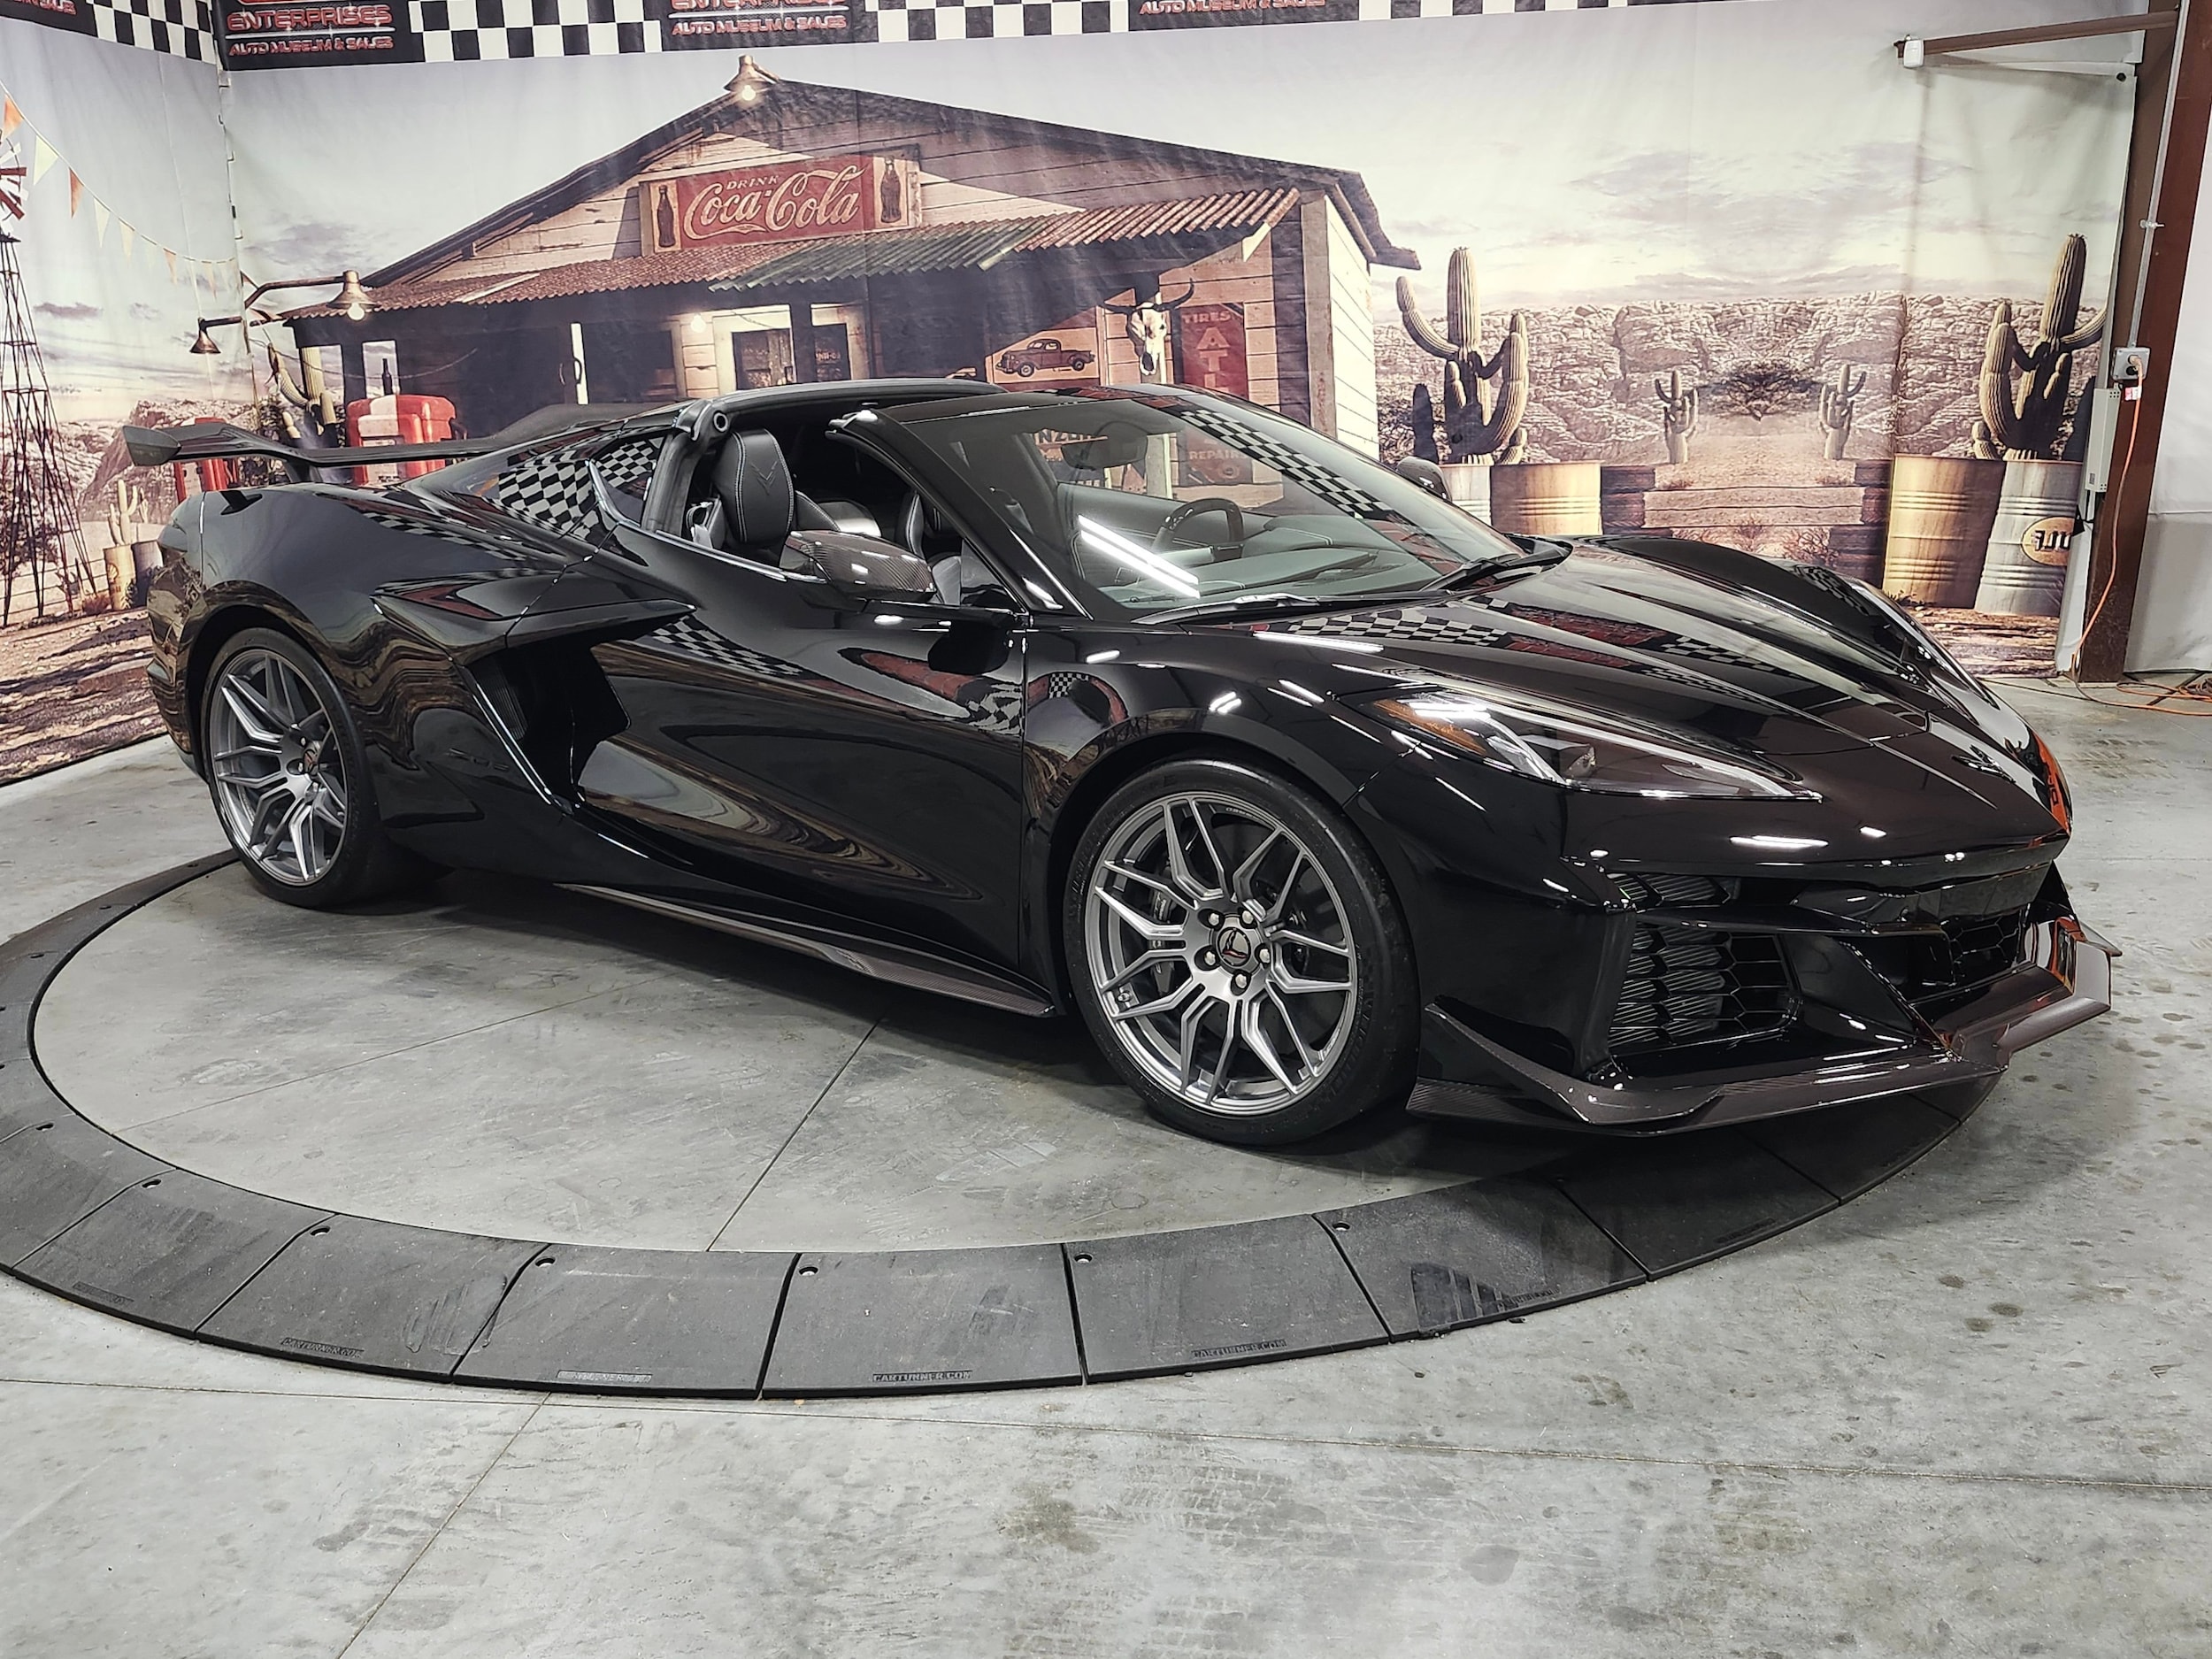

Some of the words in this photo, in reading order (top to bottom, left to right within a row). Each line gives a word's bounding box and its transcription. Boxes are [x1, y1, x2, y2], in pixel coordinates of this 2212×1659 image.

[1140, 0, 1186, 15] AUTO
[1187, 0, 1256, 12] MUSEUM
[227, 4, 394, 31] ENTERPRISES
[672, 20, 715, 35] AUTO
[716, 18, 782, 34] MUSEUM
[784, 17, 796, 31] &
[797, 15, 847, 30] SALES
[229, 41, 269, 57] AUTO
[270, 38, 333, 54] MUSEUM
[334, 37, 345, 51] &
[346, 35, 395, 50] SALES
[726, 174, 780, 191] DRINK
[1181, 310, 1232, 324] TIRES
